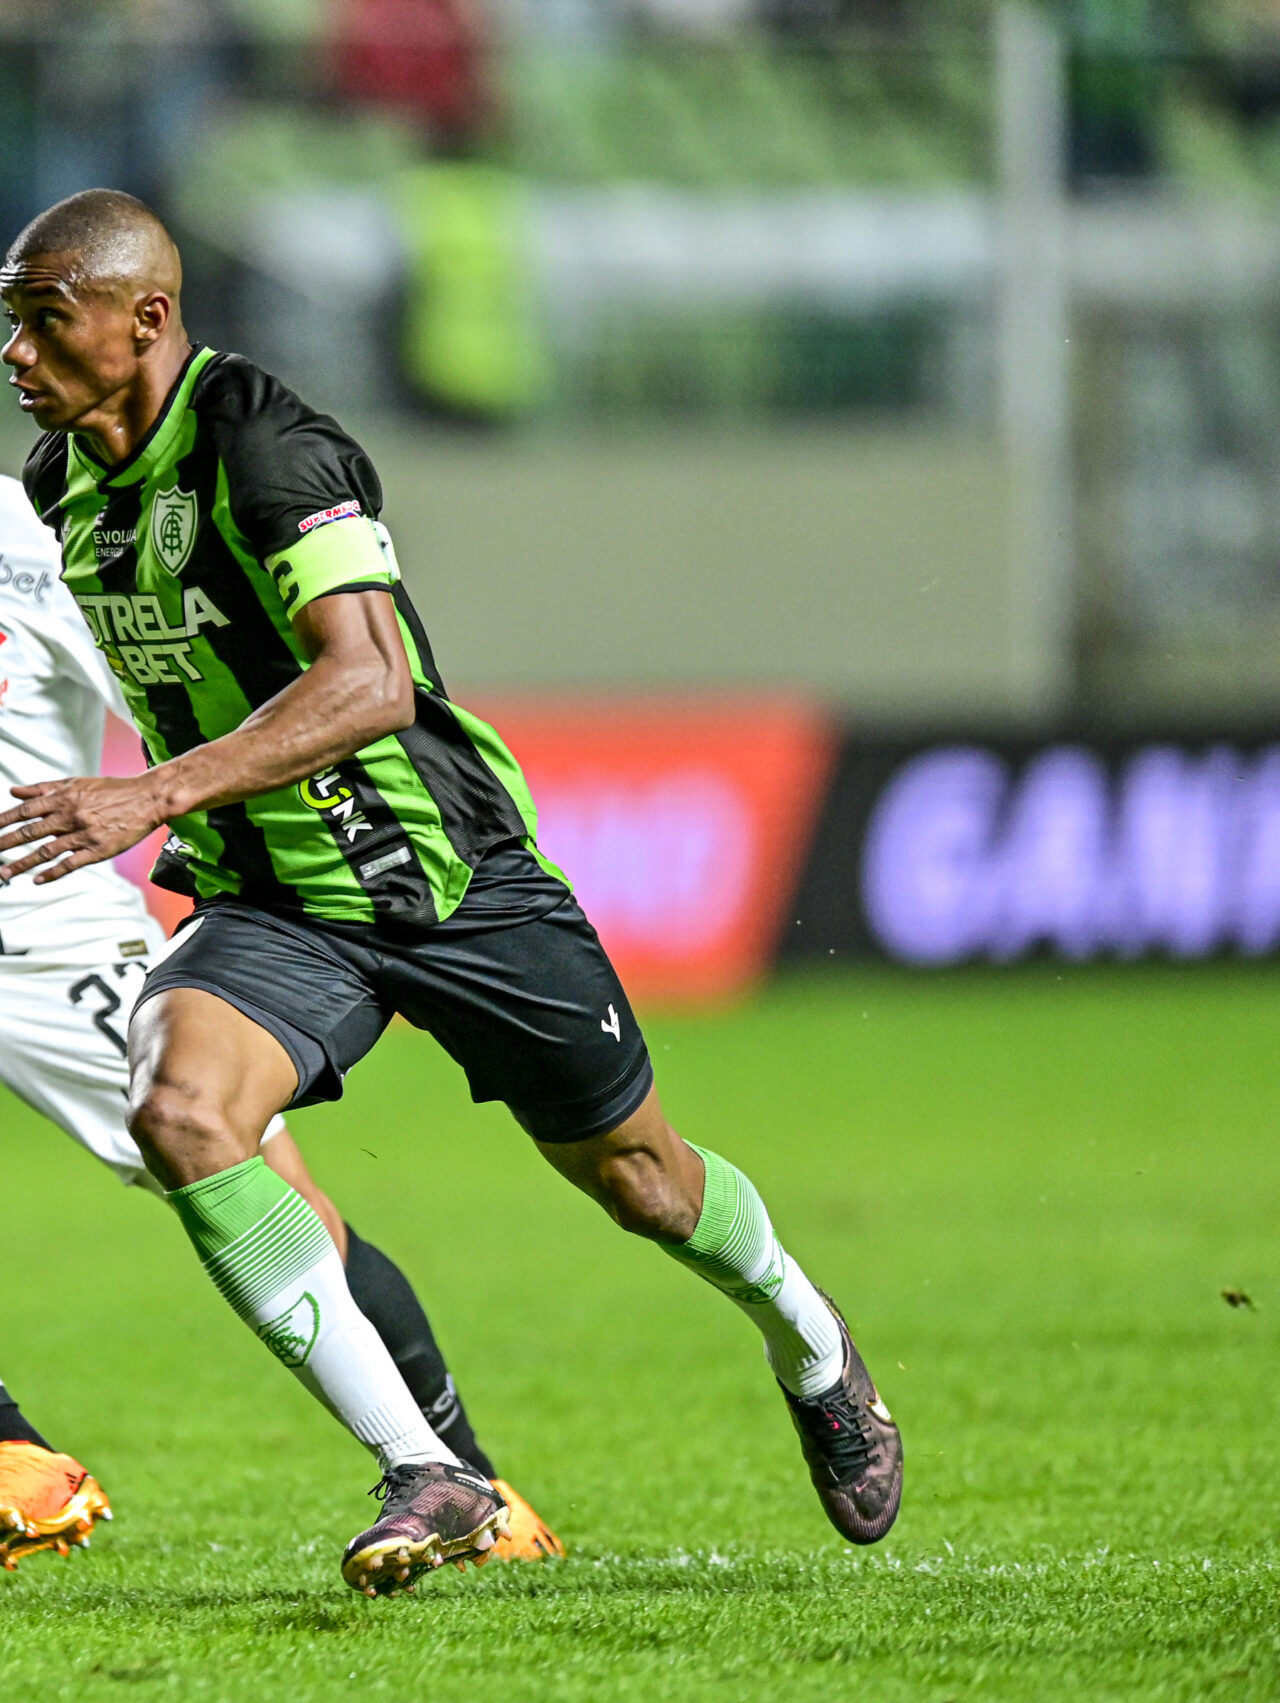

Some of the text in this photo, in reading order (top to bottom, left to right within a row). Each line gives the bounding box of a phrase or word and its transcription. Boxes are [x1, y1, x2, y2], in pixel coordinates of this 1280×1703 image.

[92, 529, 137, 544] EVOLUA
[118, 642, 203, 685] BET
[68, 960, 149, 1059] 2
